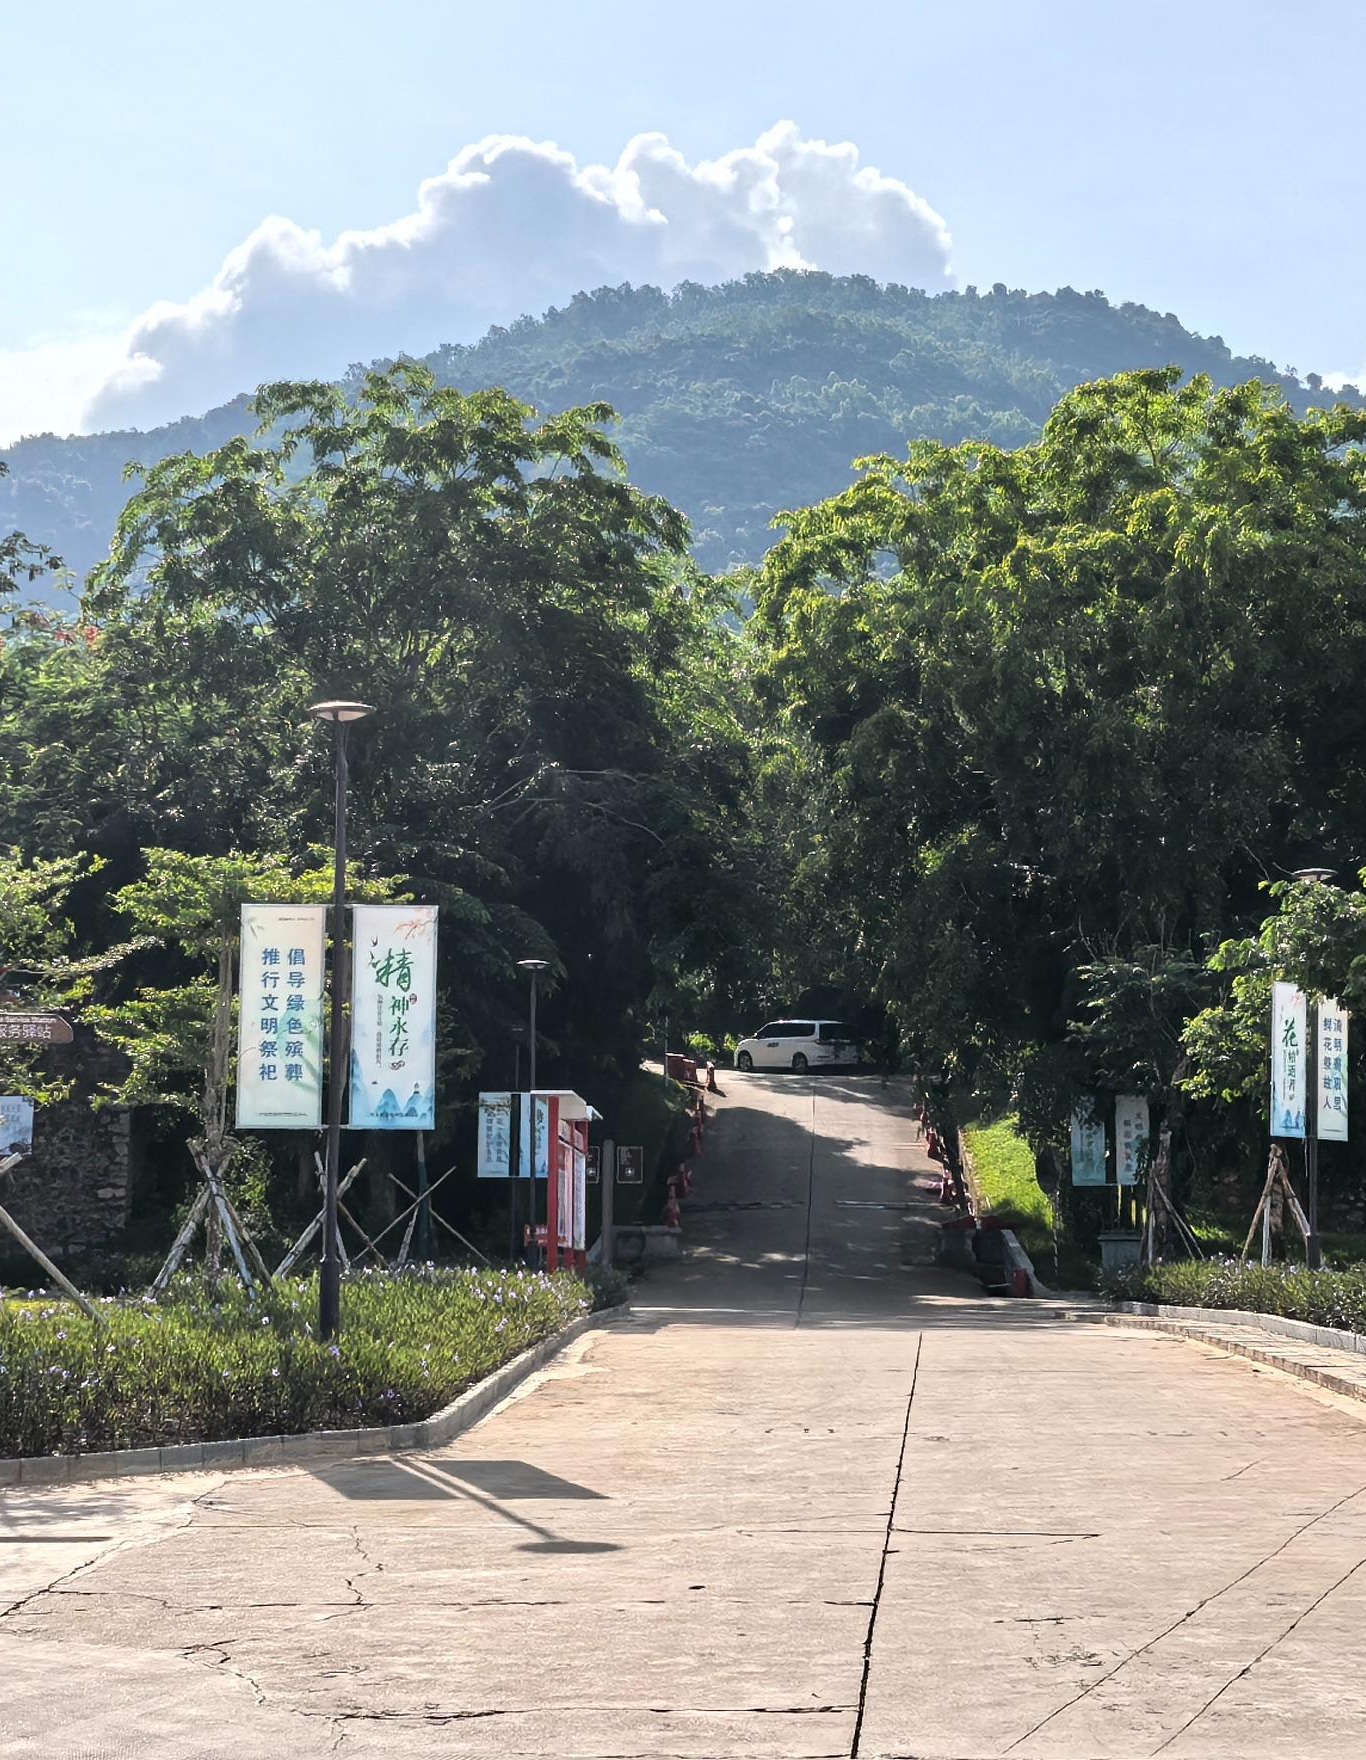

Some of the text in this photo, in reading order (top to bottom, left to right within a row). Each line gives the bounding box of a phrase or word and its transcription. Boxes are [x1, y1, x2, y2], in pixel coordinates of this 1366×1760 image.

[259, 948, 281, 1082] 推行文明祭祀
[285, 948, 306, 1082] 倡导绿色殡葬
